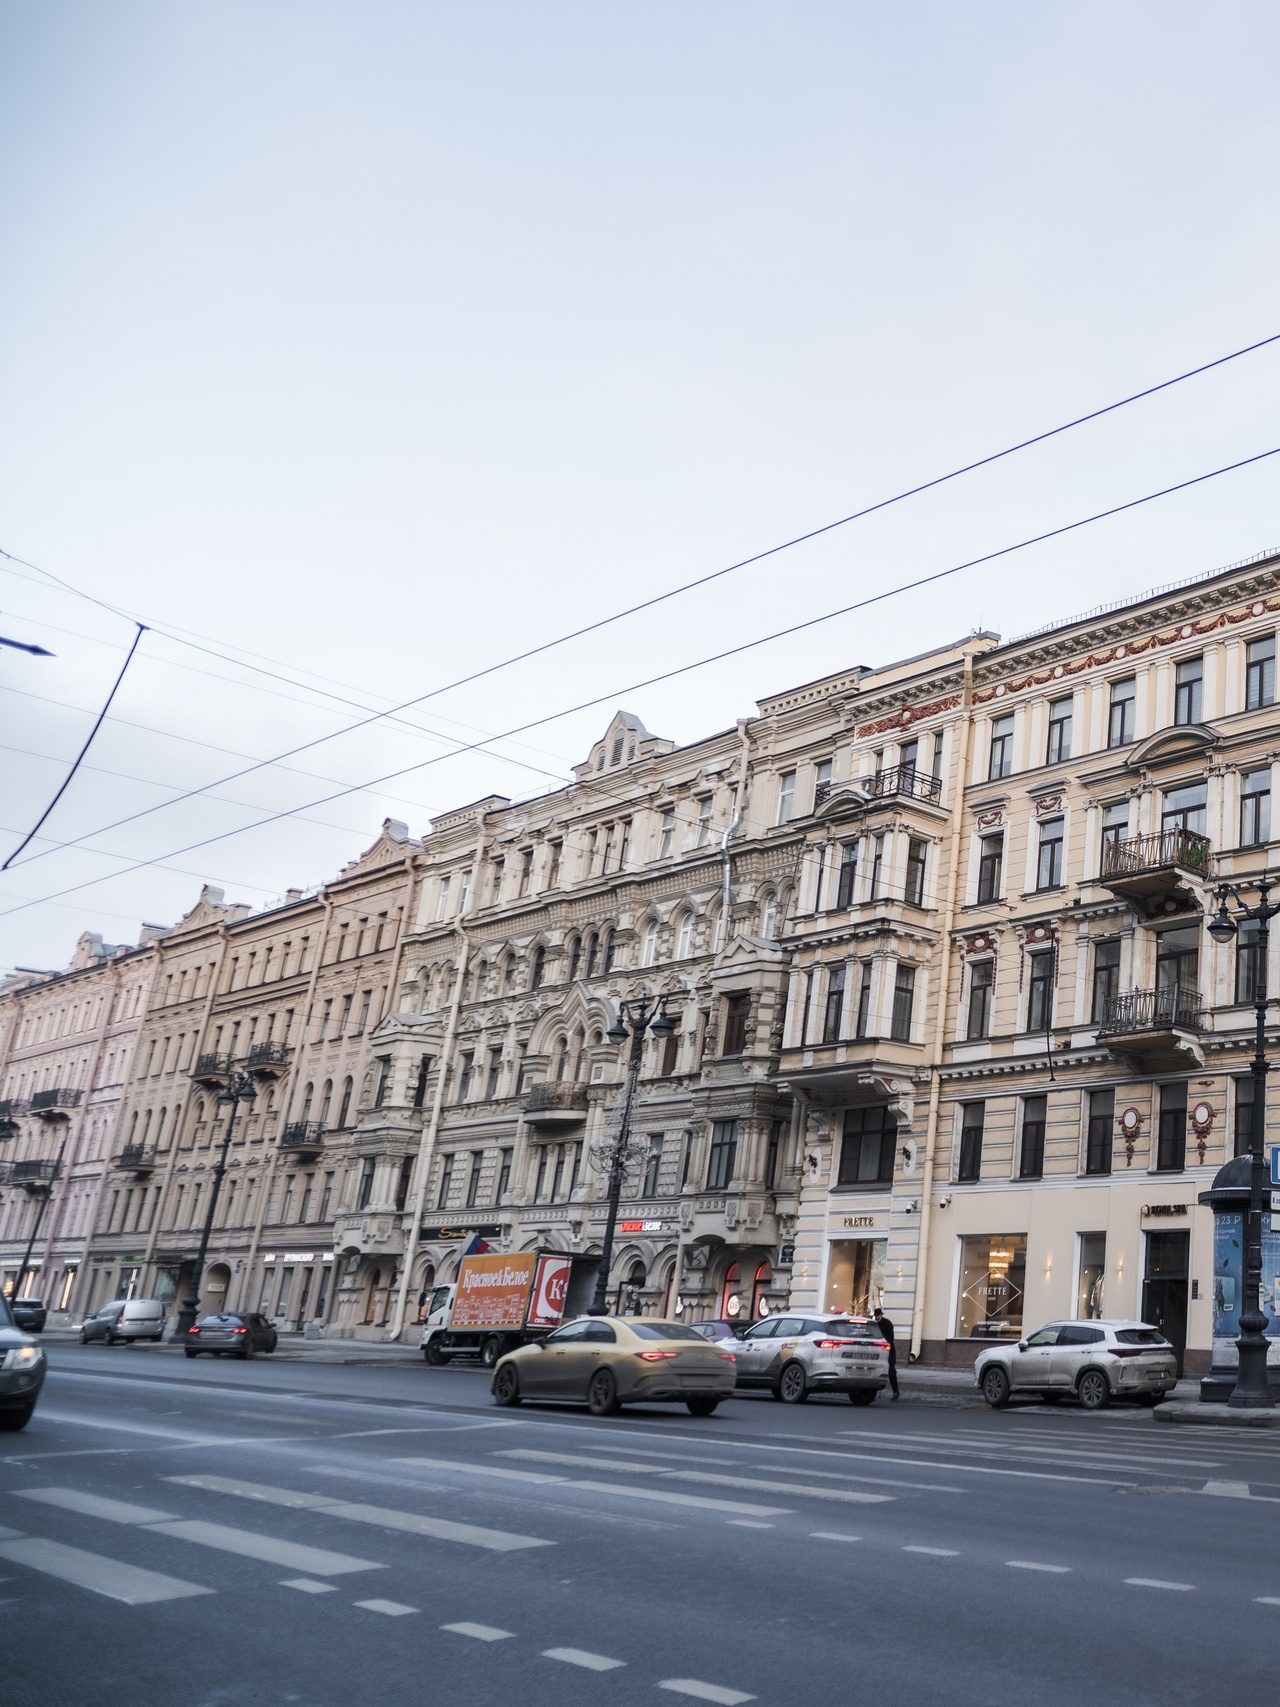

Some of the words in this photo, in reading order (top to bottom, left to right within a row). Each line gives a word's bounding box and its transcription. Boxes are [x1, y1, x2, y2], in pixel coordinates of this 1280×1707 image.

[843, 1217, 874, 1227] FRETTE
[462, 1266, 530, 1293] Красное&Белое
[978, 1286, 1007, 1296] FRETTE
